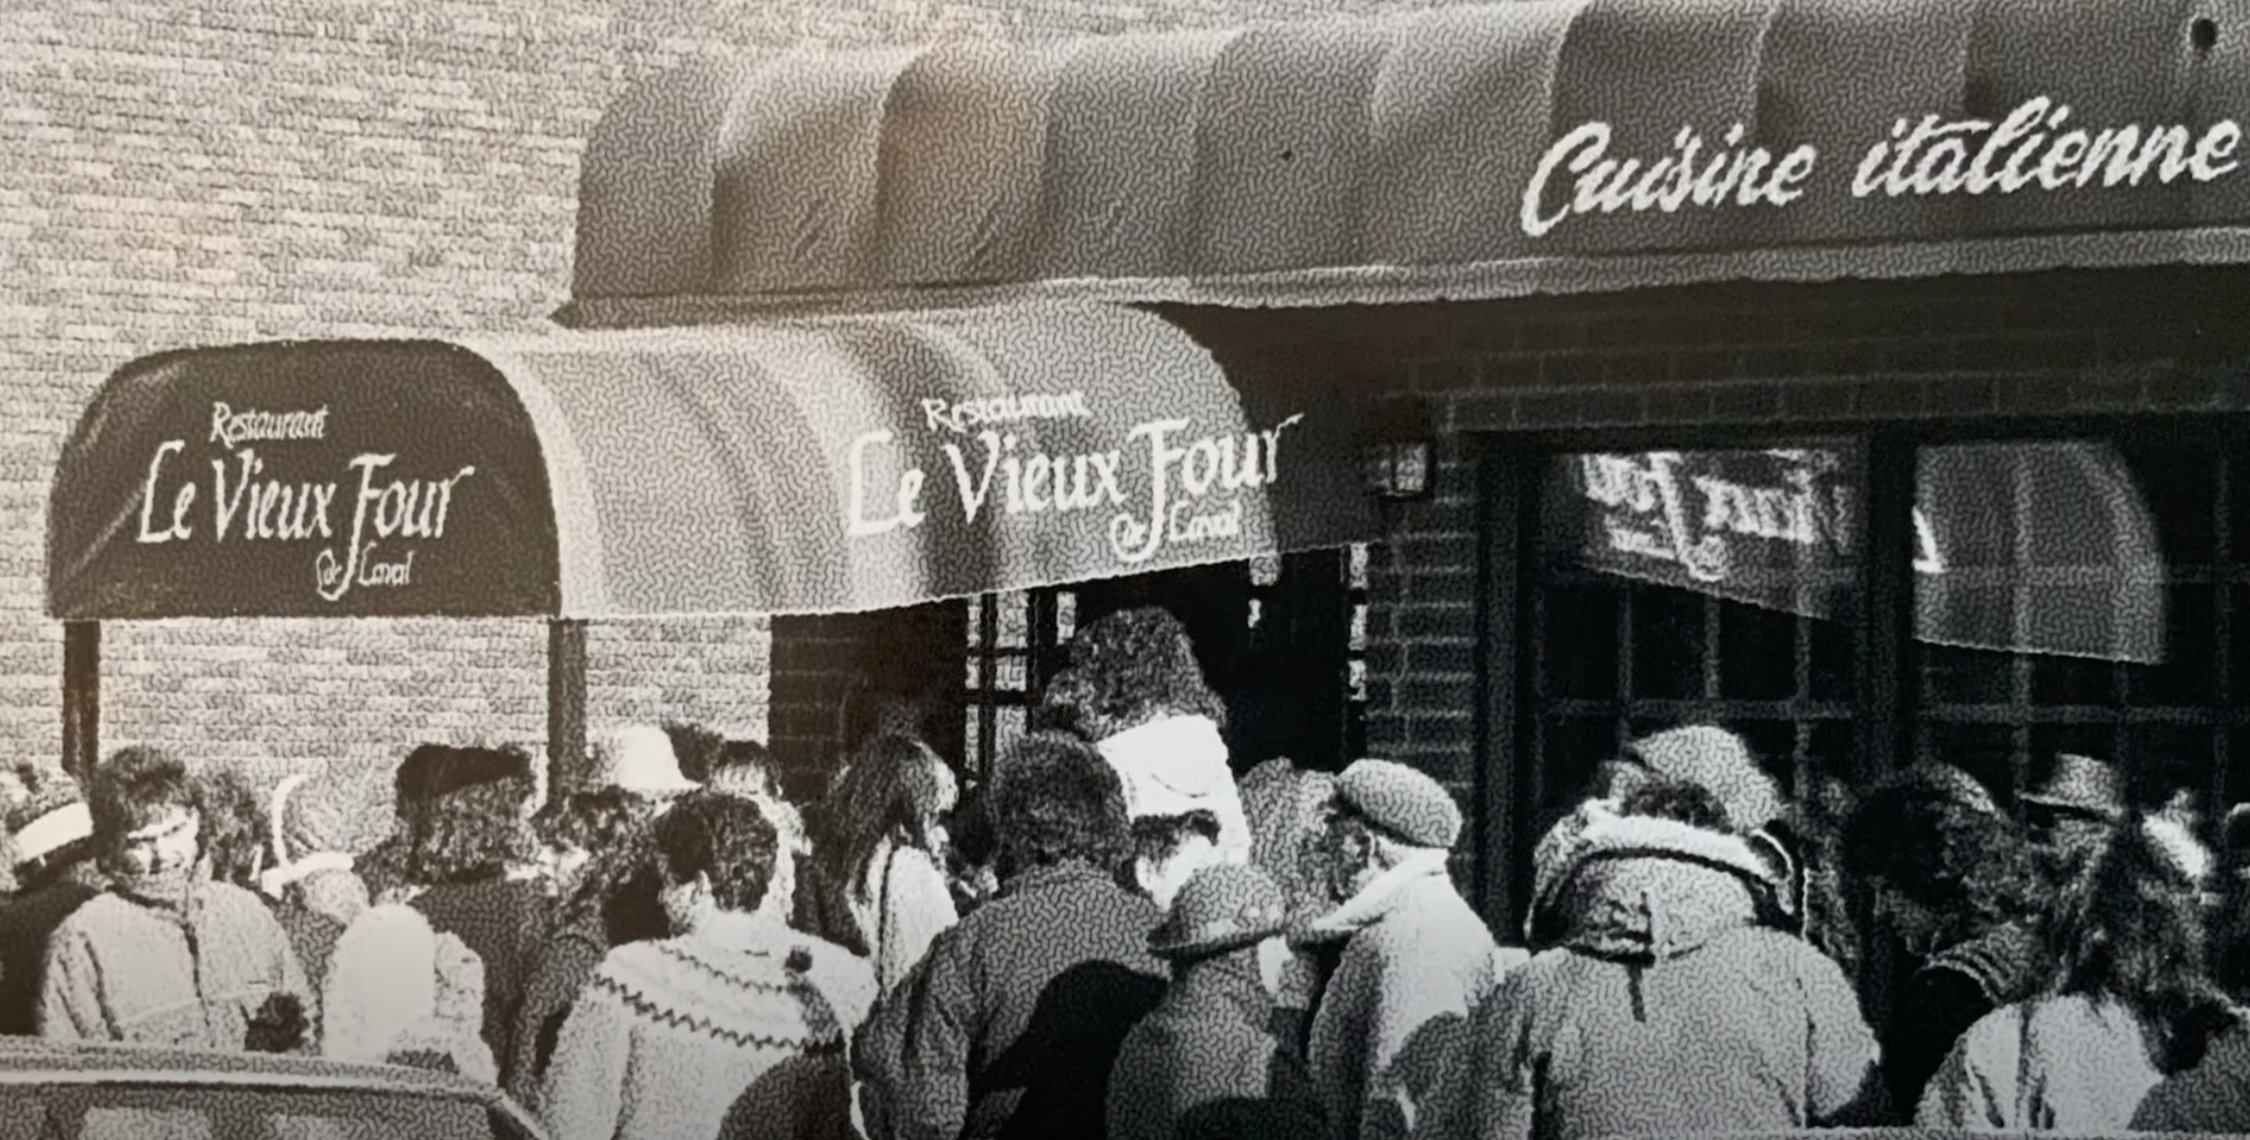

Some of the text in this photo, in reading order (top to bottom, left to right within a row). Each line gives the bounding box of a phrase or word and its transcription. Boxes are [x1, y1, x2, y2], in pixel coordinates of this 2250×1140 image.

[1521, 96, 2240, 236] Cuisine italienne
[209, 401, 329, 449] Restaurant
[921, 391, 1090, 433] Restaurant
[136, 439, 476, 600] Le Vieux Four
[847, 413, 1304, 561] Le Vieux Four
[358, 541, 415, 587] Laval
